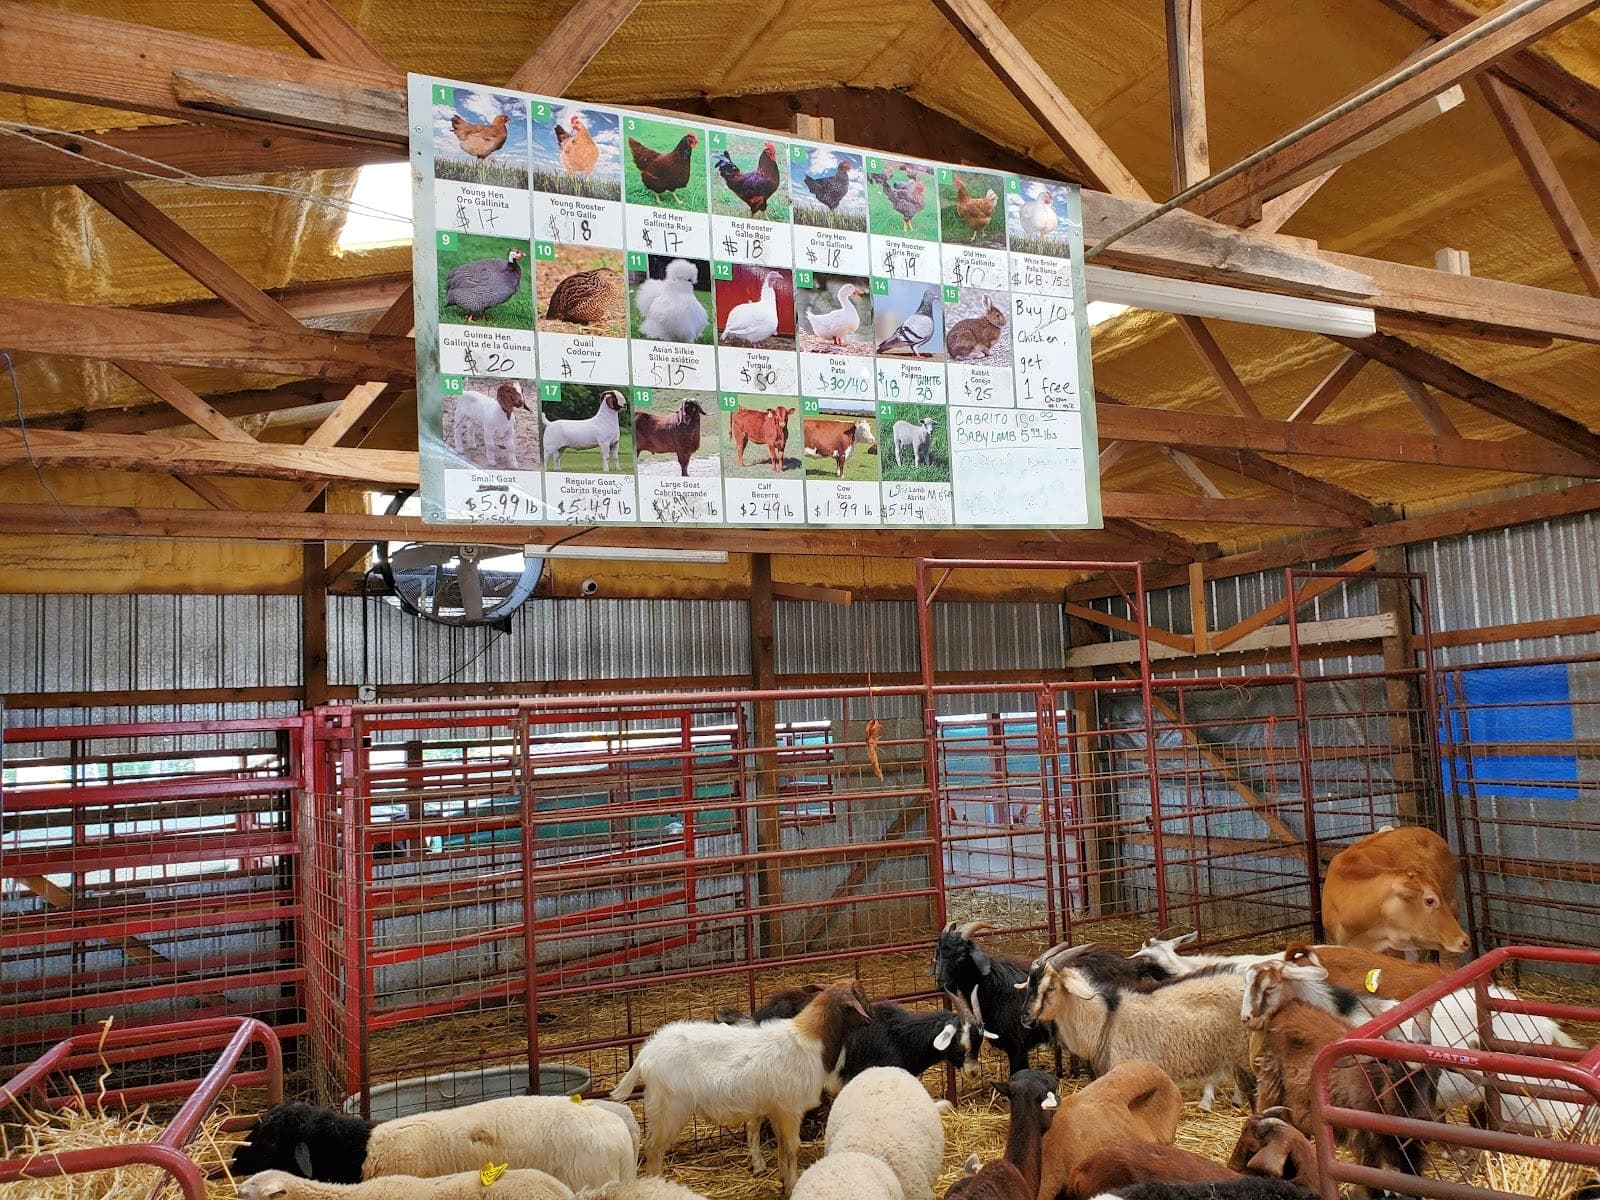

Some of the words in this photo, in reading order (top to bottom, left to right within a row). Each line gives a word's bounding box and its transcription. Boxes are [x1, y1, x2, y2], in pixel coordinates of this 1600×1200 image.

[439, 89, 446, 99] 1
[537, 106, 545, 116] 2
[628, 120, 635, 130] 3
[713, 135, 720, 144] 4
[794, 148, 801, 156] 5
[870, 160, 877, 168] 6
[941, 171, 947, 179] 7
[1010, 181, 1016, 189] 8
[461, 187, 486, 199] Young
[488, 190, 504, 199] Hen
[456, 195, 472, 204] Oro
[474, 197, 509, 208] Gallinita
[550, 199, 574, 210] Young
[576, 202, 606, 212] Rooster
[560, 209, 575, 217] Oro
[577, 210, 597, 219] Gallo
[653, 212, 666, 220] Red
[669, 214, 683, 222] Hen
[643, 219, 675, 229] Gallinita
[677, 223, 693, 232] Roja
[731, 221, 744, 231] Red
[746, 223, 773, 232] Rooster
[442, 235, 450, 245] 9
[735, 230, 753, 239] Gallo
[754, 232, 771, 241] Rojo
[816, 232, 831, 242] Grey
[810, 239, 825, 247] Gris
[826, 240, 853, 250] Gallinita
[885, 240, 900, 249] Grey
[902, 242, 925, 251] Rooster
[538, 245, 551, 256] 10
[892, 248, 905, 256] Gris
[906, 251, 920, 259] Rojo
[975, 251, 987, 259] Hen
[631, 256, 641, 266] 11
[971, 259, 995, 267] Gallinita
[1024, 257, 1039, 265] White
[1041, 259, 1058, 267] Broiler
[717, 265, 729, 276] 12
[799, 273, 810, 283] 13
[875, 281, 886, 290] 14
[946, 289, 955, 298] 15
[1016, 299, 1043, 328] Buy
[1048, 303, 1067, 323] 10
[463, 330, 493, 340] Guinea
[495, 332, 511, 341] Hen
[443, 338, 479, 349] Gallinita
[481, 340, 491, 349] de
[493, 341, 501, 349] la
[502, 343, 531, 352] Guinea
[573, 339, 594, 348] Quail
[566, 347, 601, 357] Codorniz
[652, 345, 672, 354] Asian
[674, 346, 694, 356] Silkie
[648, 354, 669, 363] Silkie
[670, 355, 699, 365] asiático
[747, 353, 769, 363] Turkey
[829, 358, 846, 366] Duck
[901, 363, 922, 373] Pigeon
[1020, 353, 1043, 374] get
[901, 371, 922, 379] Paloma
[971, 369, 990, 377] Rabbit
[444, 379, 459, 390] 16
[1023, 378, 1034, 399] 1
[1041, 377, 1075, 395] free
[545, 385, 558, 395] 17
[636, 391, 649, 402] 18
[723, 397, 736, 406] 19
[804, 401, 817, 411] 20
[880, 405, 892, 415] 21
[955, 409, 1008, 426] CABRITO
[957, 427, 988, 447] BABY
[991, 430, 1017, 443] LAMB
[1043, 428, 1058, 440] lbs
[471, 475, 494, 483] Small
[496, 475, 517, 483] Goat
[565, 477, 595, 487] Regular
[597, 478, 616, 486] Goat
[660, 480, 682, 490] Large
[682, 481, 701, 489] Goat
[836, 484, 850, 492] Cow
[560, 486, 590, 494] Cabrito
[592, 487, 622, 496] Regular
[653, 489, 682, 497] Cabrito
[682, 490, 708, 499] grande
[751, 491, 779, 499] Becerro
[525, 498, 538, 514] lb
[618, 500, 632, 515] lb
[707, 501, 718, 516] lb
[783, 503, 794, 517] lb
[864, 505, 873, 516] lb
[1426, 1050, 1480, 1065] TARTR
